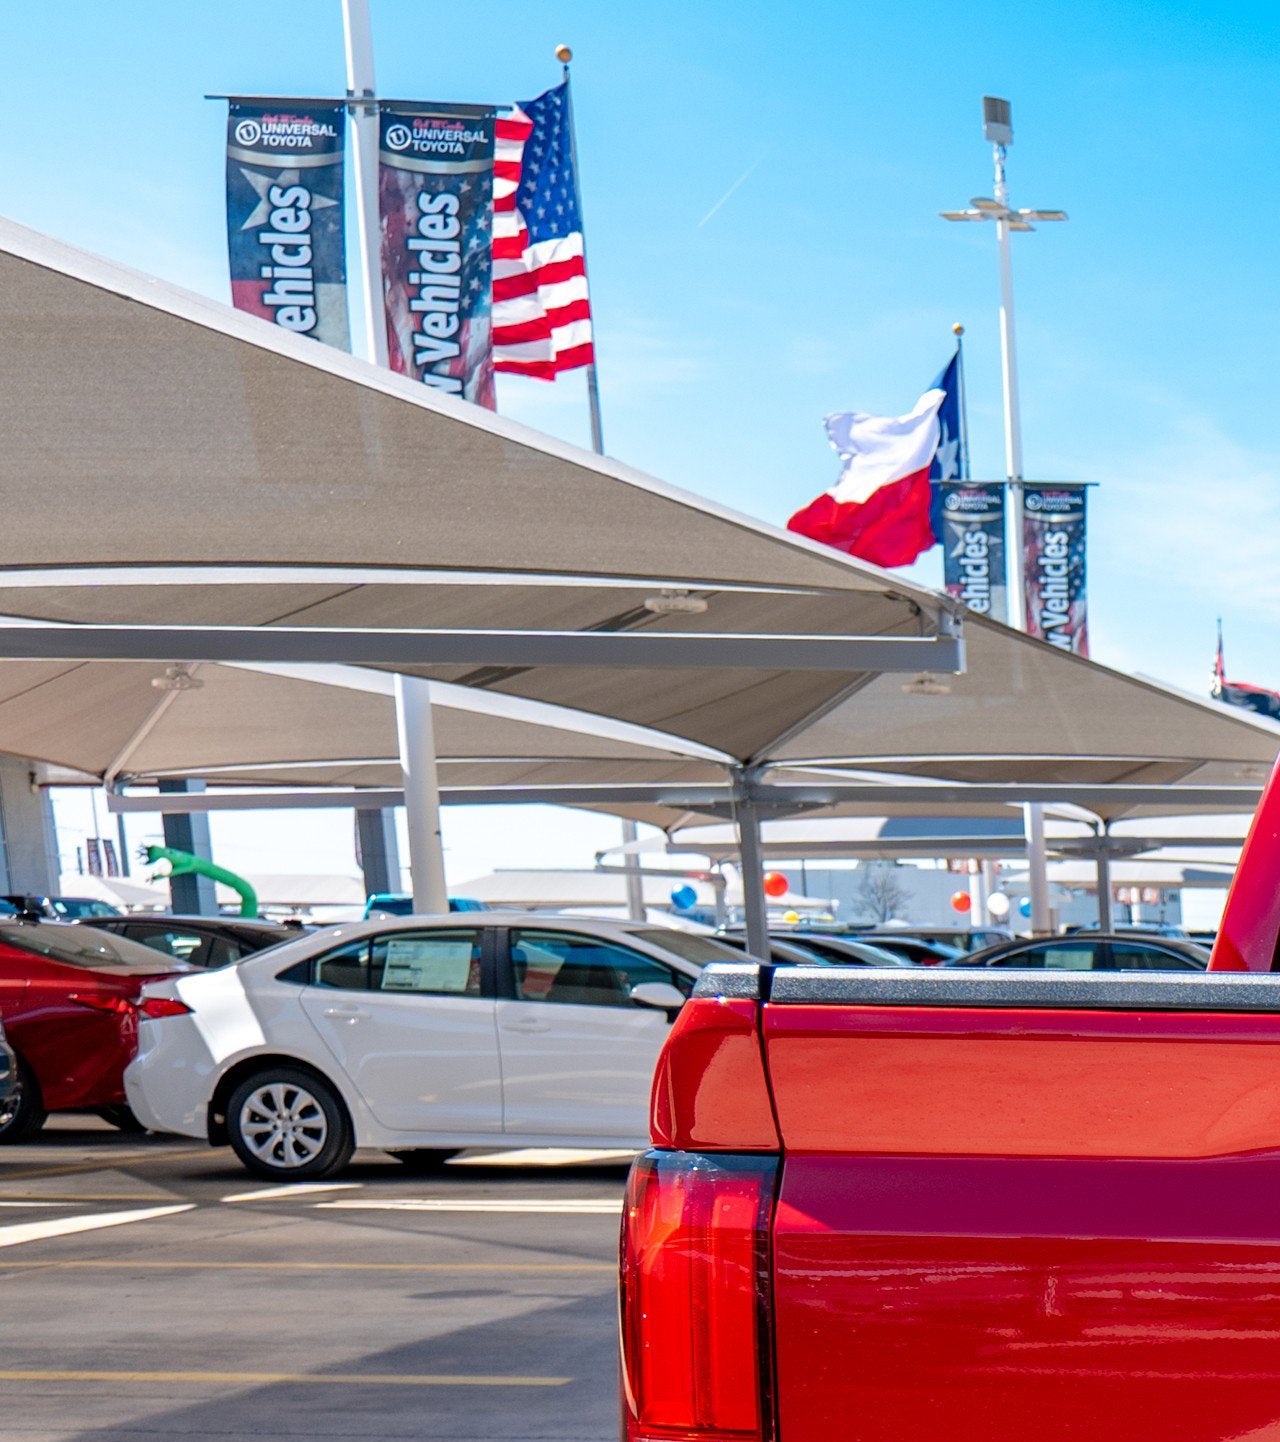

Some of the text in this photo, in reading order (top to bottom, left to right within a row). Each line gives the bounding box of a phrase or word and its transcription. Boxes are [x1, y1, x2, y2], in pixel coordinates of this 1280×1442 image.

[261, 123, 337, 137] UNIVERSAL
[412, 128, 489, 144] UNIVERSAL
[261, 134, 313, 148] TOYOTA
[412, 140, 465, 155] TOYOTA
[259, 185, 318, 332] ehicles
[959, 530, 989, 614] ehicles
